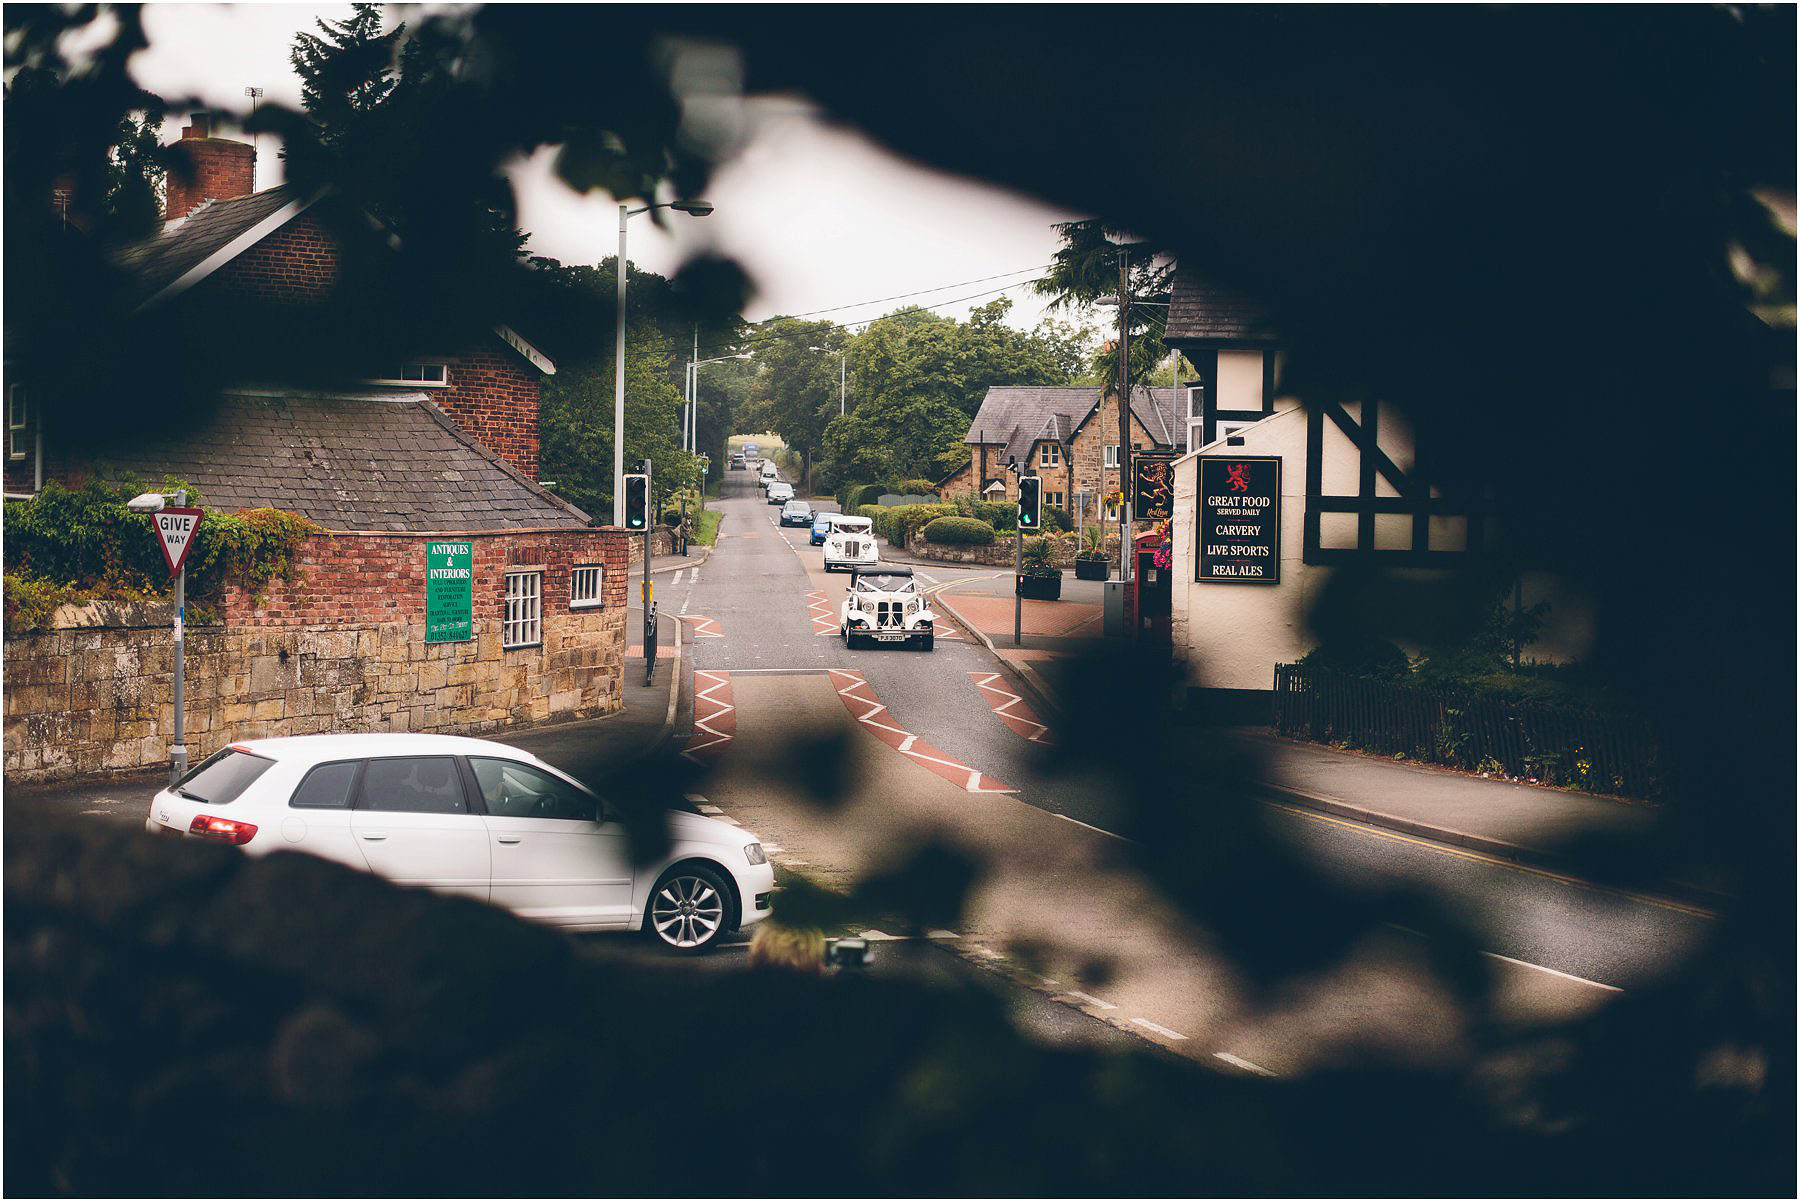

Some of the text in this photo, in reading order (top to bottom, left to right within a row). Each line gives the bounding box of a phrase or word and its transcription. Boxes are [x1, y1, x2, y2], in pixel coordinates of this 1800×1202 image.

[1207, 496, 1270, 507] GREAT FOOD
[1216, 508, 1261, 516] SERVED DAILY
[160, 516, 190, 531] GIVE
[1215, 524, 1261, 536] CARVERY
[166, 534, 186, 544] WAY
[432, 544, 468, 556] ANTIQUES
[1207, 544, 1269, 557] LIVE SPORTS
[446, 556, 453, 566] &
[430, 569, 470, 579] INTERIORS
[1212, 565, 1263, 576] REAL ALES
[430, 632, 446, 640] 01352
